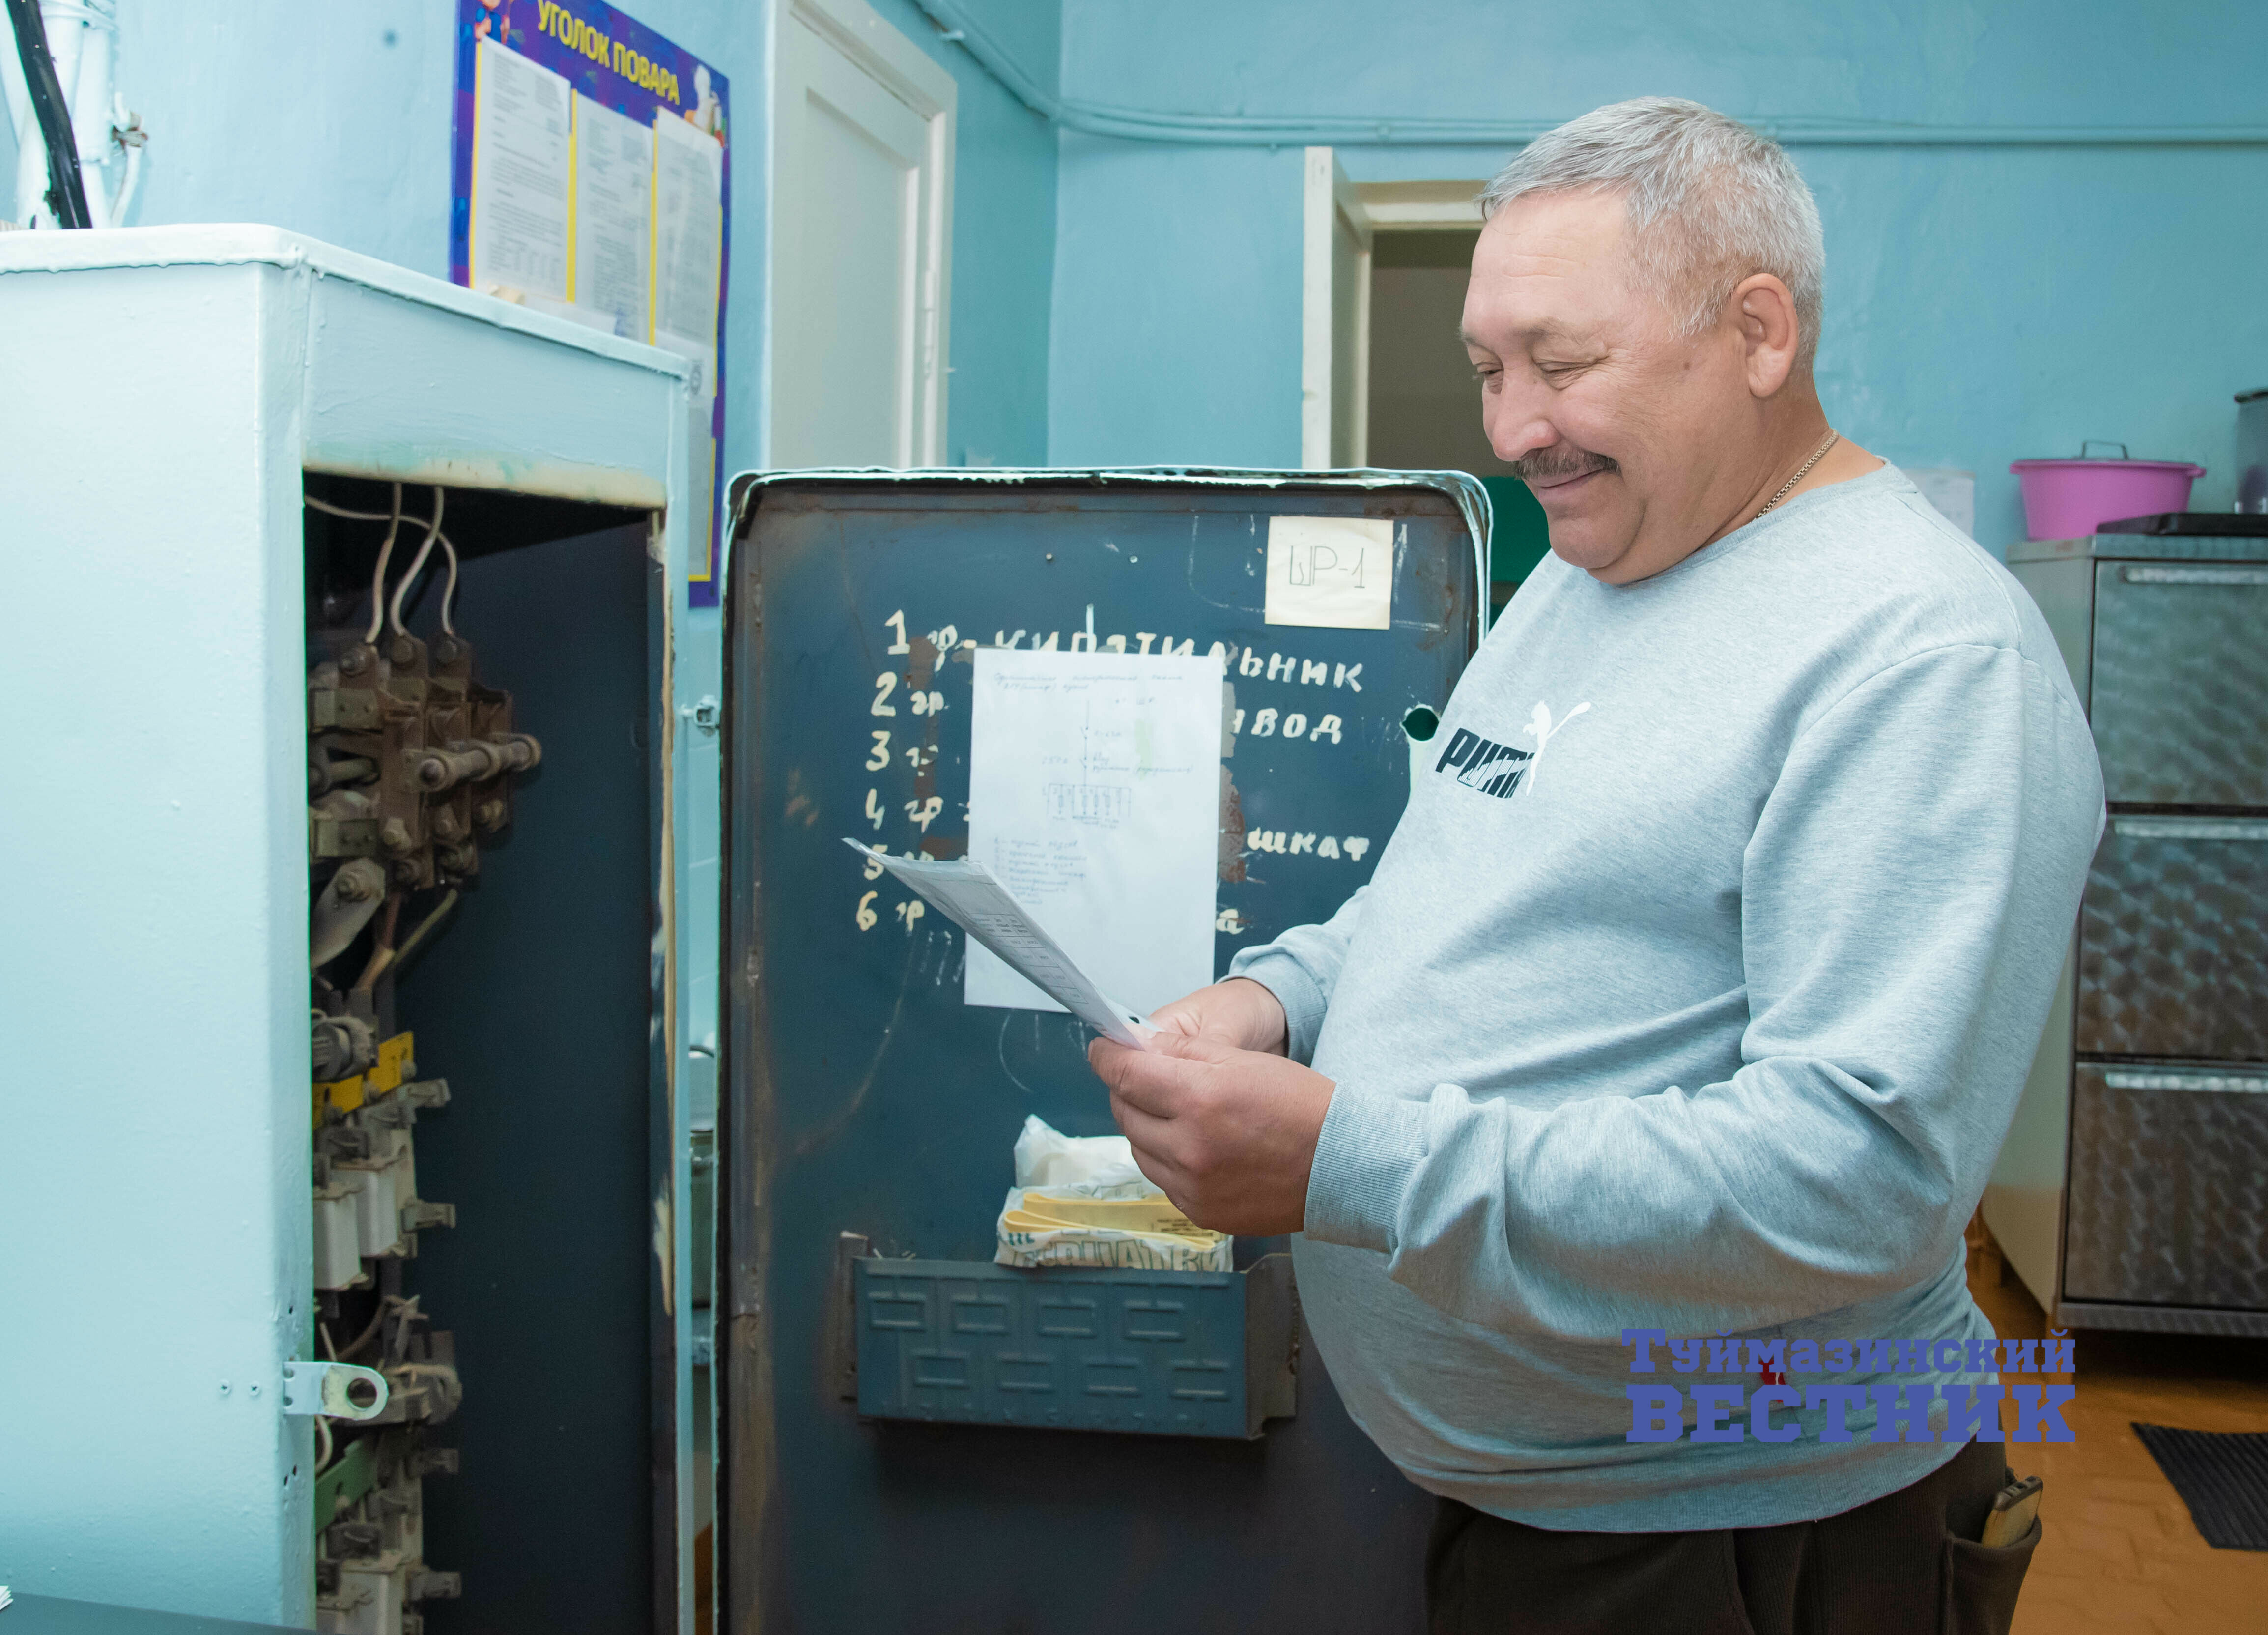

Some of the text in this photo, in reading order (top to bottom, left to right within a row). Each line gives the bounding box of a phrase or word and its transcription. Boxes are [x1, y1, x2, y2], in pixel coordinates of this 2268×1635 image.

[538, 0, 680, 105] УГОЛОК ПОВАРА
[885, 609, 910, 655] 1
[871, 671, 897, 717] 2
[866, 730, 891, 771] 3
[866, 788, 885, 830] 4
[856, 891, 878, 932] 6
